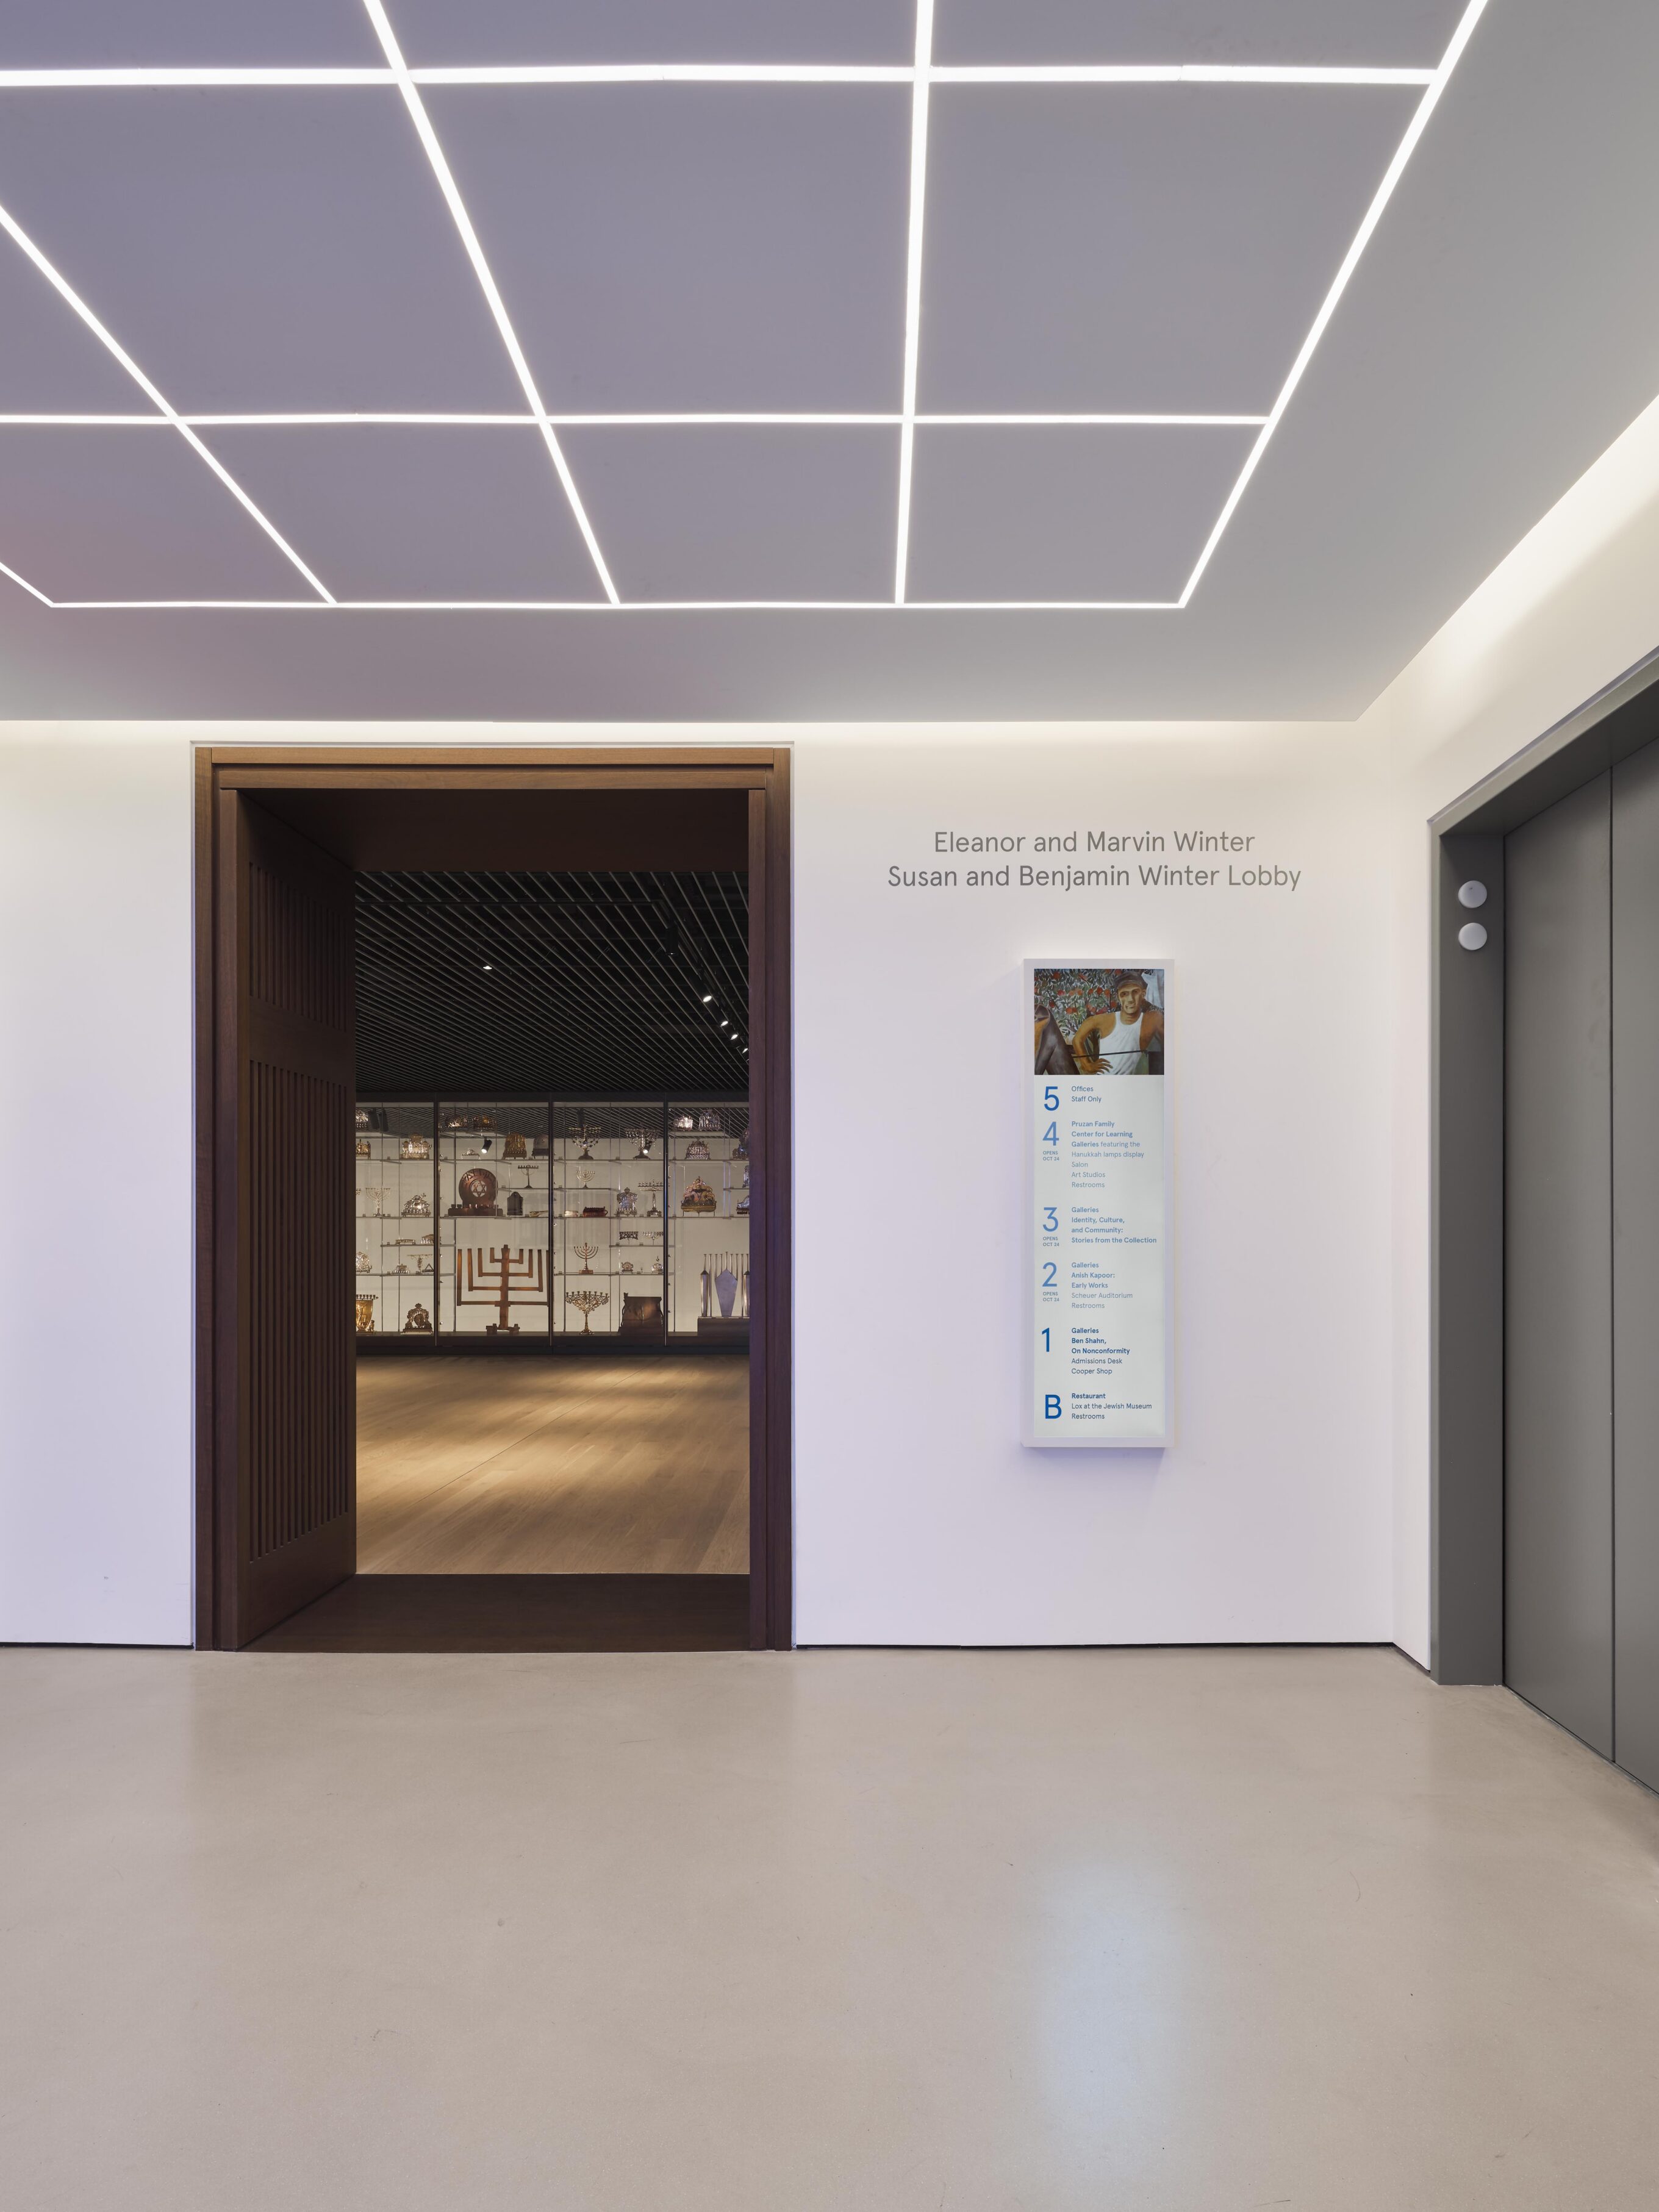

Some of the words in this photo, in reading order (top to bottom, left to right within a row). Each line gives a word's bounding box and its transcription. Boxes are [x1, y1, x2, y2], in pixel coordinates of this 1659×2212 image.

[934, 831, 1027, 853] Eleanor
[1033, 831, 1077, 853] and
[1087, 830, 1165, 852] Marvin
[1173, 830, 1256, 852] Winter
[887, 865, 957, 887] Susan
[966, 865, 1009, 887] and
[1020, 864, 1130, 892] Benjamin
[1138, 864, 1220, 886] Winter
[1228, 864, 1302, 892] Lobby
[1044, 1086, 1059, 1111] 5
[1042, 1122, 1059, 1146] 4
[1042, 1207, 1059, 1232] 3
[1042, 1262, 1058, 1287] 2
[1042, 1327, 1050, 1352] 1
[1045, 1394, 1062, 1419] B
